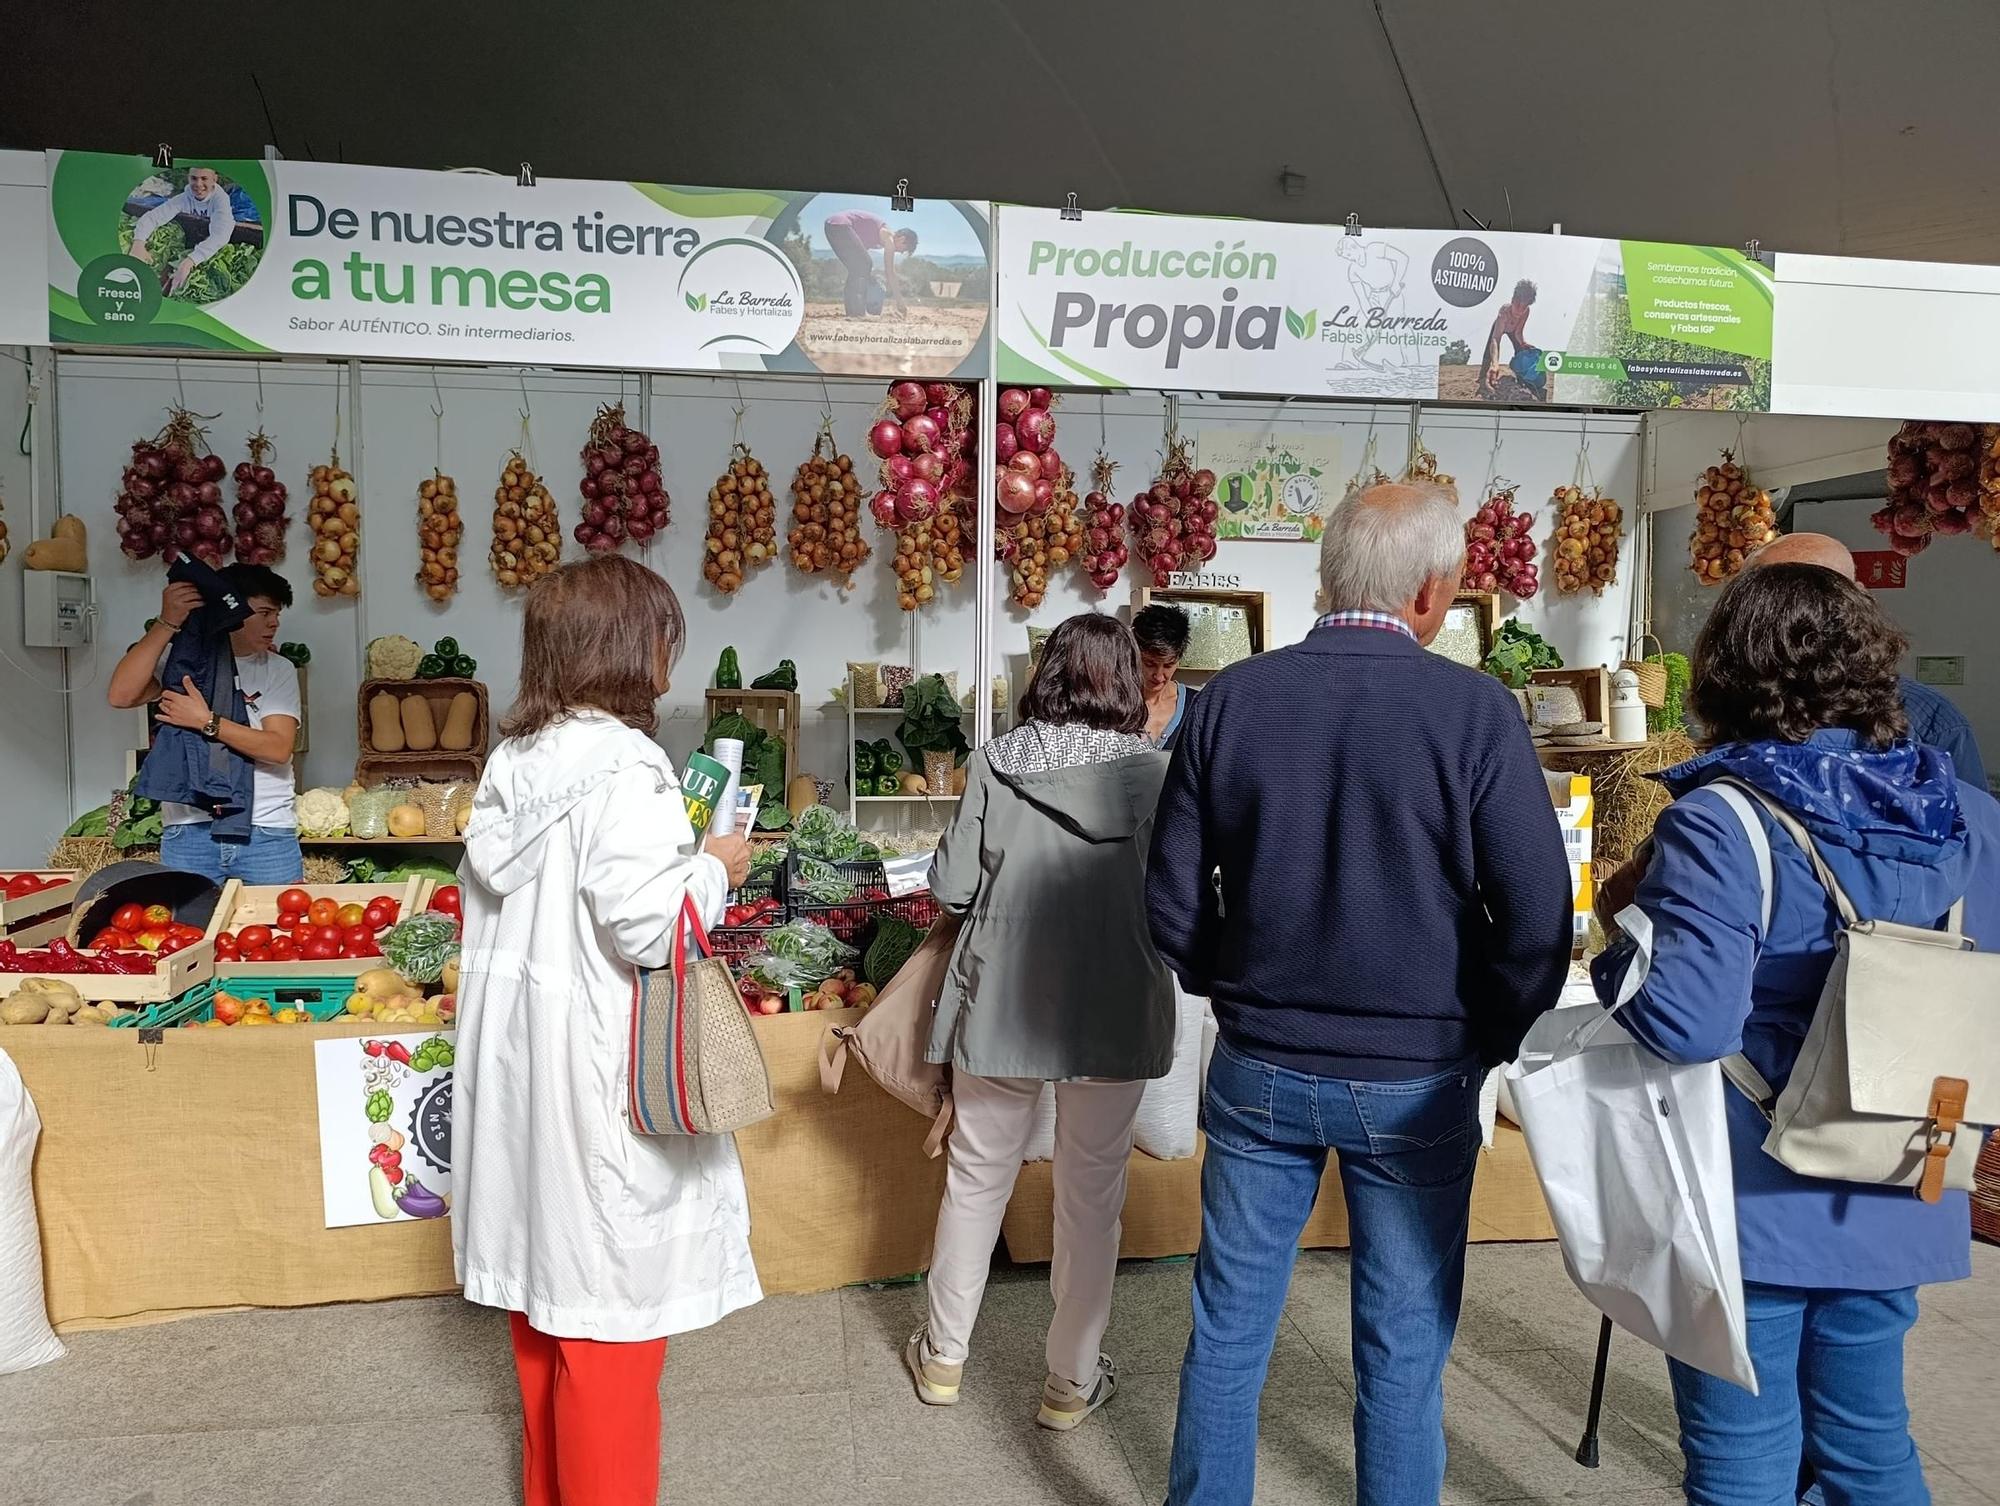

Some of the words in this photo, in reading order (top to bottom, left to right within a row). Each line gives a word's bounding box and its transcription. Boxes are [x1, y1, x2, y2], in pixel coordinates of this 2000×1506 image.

[288, 194, 359, 240] De
[371, 211, 563, 252] nuestra
[572, 211, 700, 259] tierra
[1028, 240, 1277, 280] Producción
[1449, 251, 1485, 272] 100%
[1647, 262, 1699, 275] Sembramos
[1701, 263, 1738, 277] tradición,
[291, 258, 330, 300] a
[343, 252, 415, 305] tu
[431, 265, 611, 314] mesa
[1433, 268, 1494, 294] ASTURIANO
[1652, 275, 1707, 288] cosechamos
[1708, 276, 1735, 289] futuro.
[98, 286, 141, 299] Fresco
[711, 290, 735, 306] La
[738, 291, 792, 308] Barreda
[115, 301, 124, 311] y
[710, 305, 738, 316] Fabes
[739, 307, 746, 317] y
[747, 306, 793, 317] Hortalizas
[1654, 298, 1698, 309] Productos
[1699, 300, 1732, 313] frescos,
[104, 311, 135, 322] sano
[1323, 305, 1359, 328] La
[1365, 306, 1448, 331] Barreda
[1644, 310, 1690, 322] conservas
[1690, 312, 1741, 324] artesanales
[288, 317, 335, 332] Sabor
[338, 317, 432, 337] AUTÉNTICO.
[437, 323, 461, 338] Sin
[464, 325, 576, 343] intermediarios.
[1049, 287, 1282, 369] Propia
[1671, 325, 1677, 334] y
[1677, 323, 1699, 334] Faba
[1700, 324, 1715, 335] IGP
[810, 333, 963, 346] www.fabesyhortalizaslabarreda.es
[1321, 328, 1363, 344] Fabes
[1367, 333, 1375, 347] y
[1377, 332, 1447, 346] Hortalizas
[1628, 363, 1742, 378] fabesyhortalizaslabarreda.es
[429, 1113, 445, 1141] SIN
